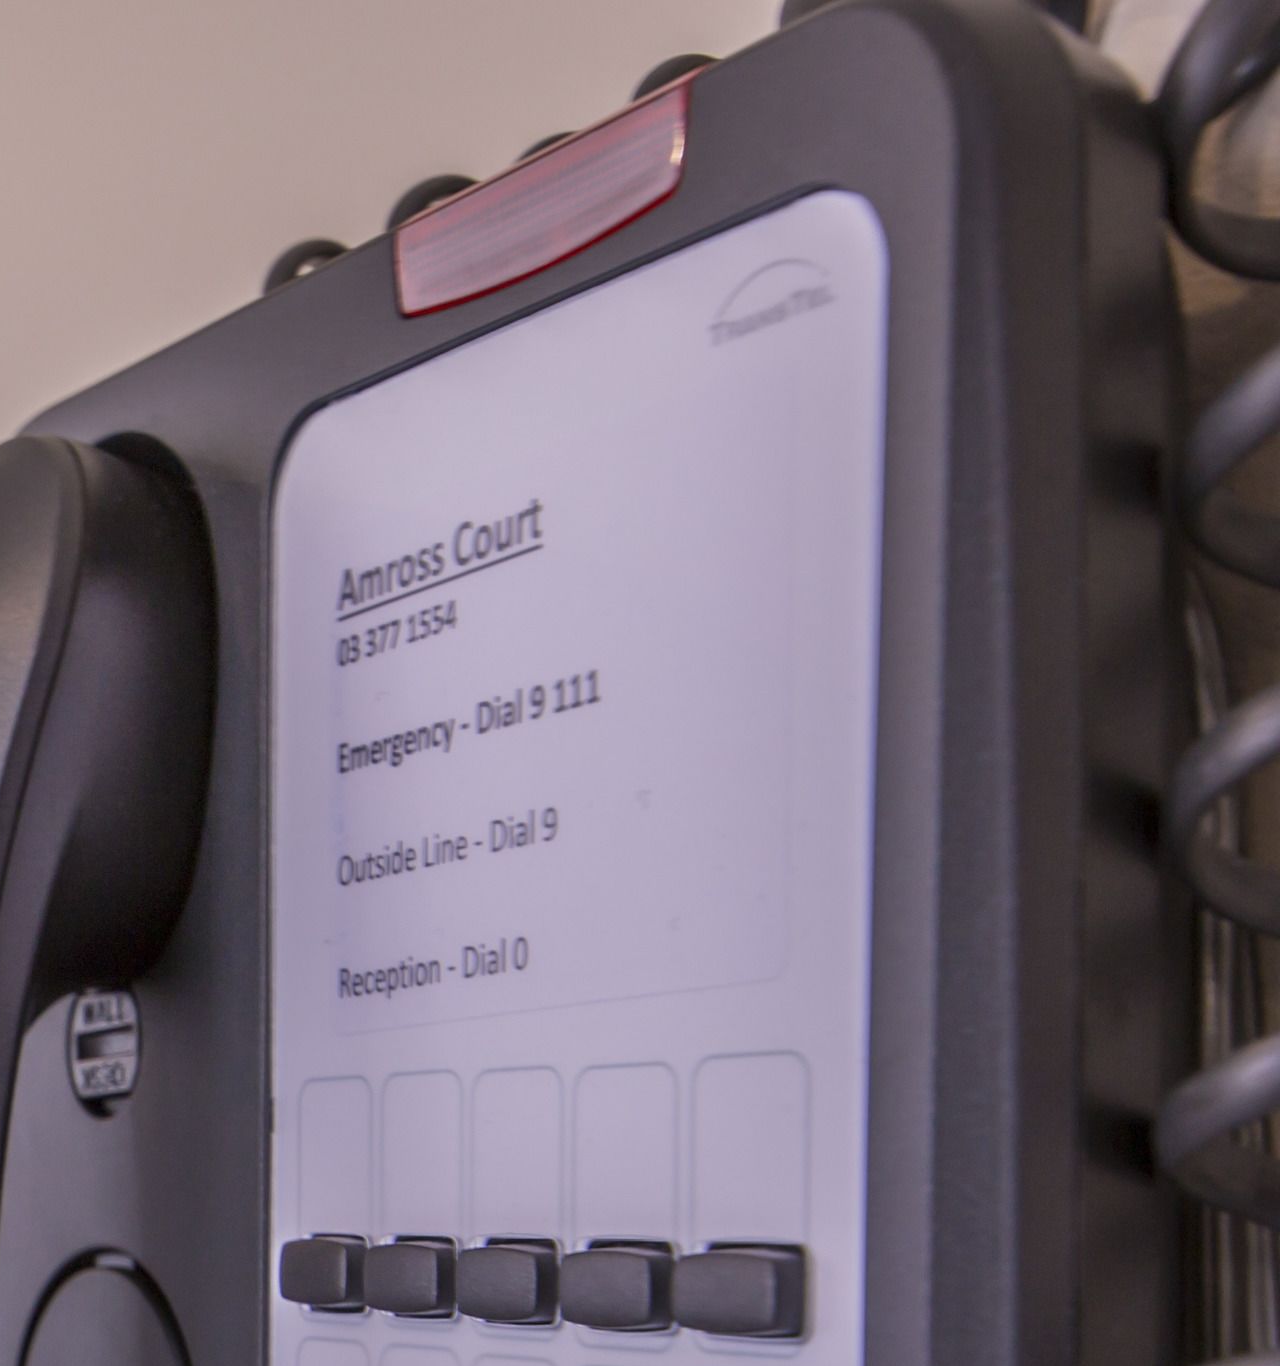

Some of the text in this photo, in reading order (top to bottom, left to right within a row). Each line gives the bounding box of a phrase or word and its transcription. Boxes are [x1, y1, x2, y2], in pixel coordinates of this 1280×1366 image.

[338, 499, 543, 611] Amross Court
[338, 600, 457, 667] 03 377 1554
[338, 719, 457, 774] Emergency
[477, 688, 523, 735] Dial
[529, 684, 547, 720] 9
[552, 669, 601, 714] 111
[338, 840, 417, 886] Outside
[423, 833, 469, 877] Line
[490, 809, 536, 853] Dial
[542, 807, 559, 842] 9
[338, 956, 441, 999] Reception
[462, 938, 507, 979] Dial
[512, 936, 530, 971] 0
